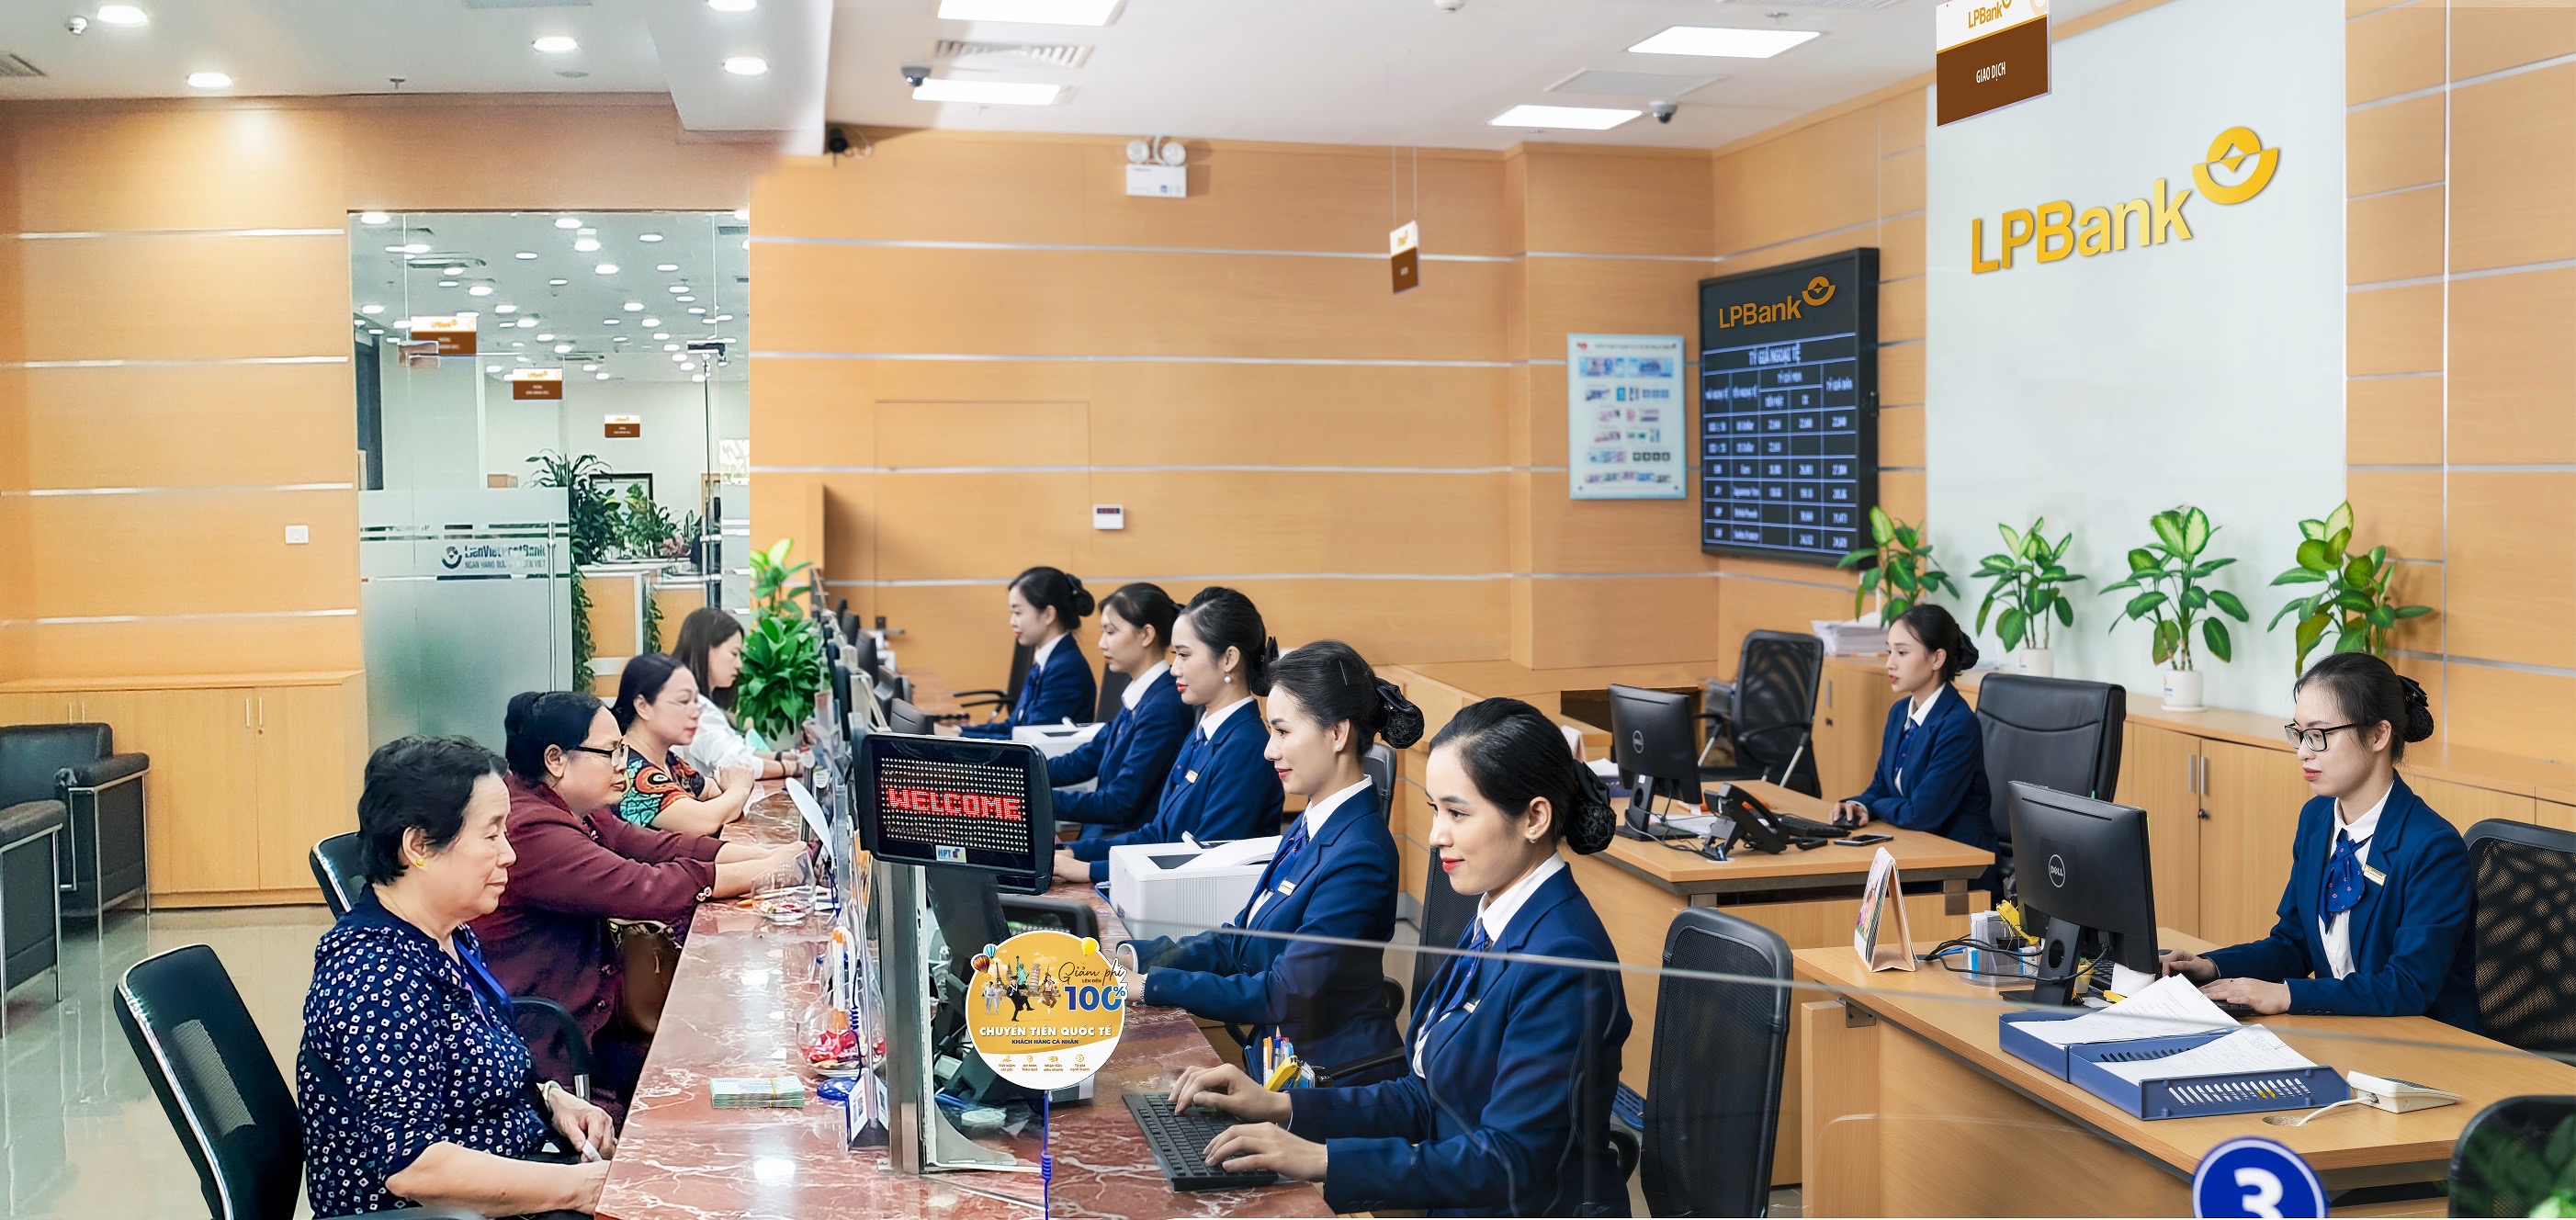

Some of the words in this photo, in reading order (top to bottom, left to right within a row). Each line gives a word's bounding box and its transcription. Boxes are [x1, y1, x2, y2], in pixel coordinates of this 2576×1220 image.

[1968, 2, 2003, 28] LPBank
[1976, 66, 1991, 84] GIAO
[1991, 61, 2006, 82] DỊCH
[1971, 178, 2193, 275] LPBank
[1719, 295, 1802, 329] LPBank
[887, 788, 1022, 821] WELCOME
[2051, 865, 2064, 877] DELL
[1058, 962, 1100, 985] Giảm
[1102, 958, 1125, 986] phí
[979, 1023, 1026, 1037] CHUYỂN
[1031, 1023, 1056, 1037] TIỀN
[1060, 1023, 1095, 1037] QUỐC
[1098, 1023, 1112, 1036] TẾ
[2233, 1167, 2285, 1218] 3
